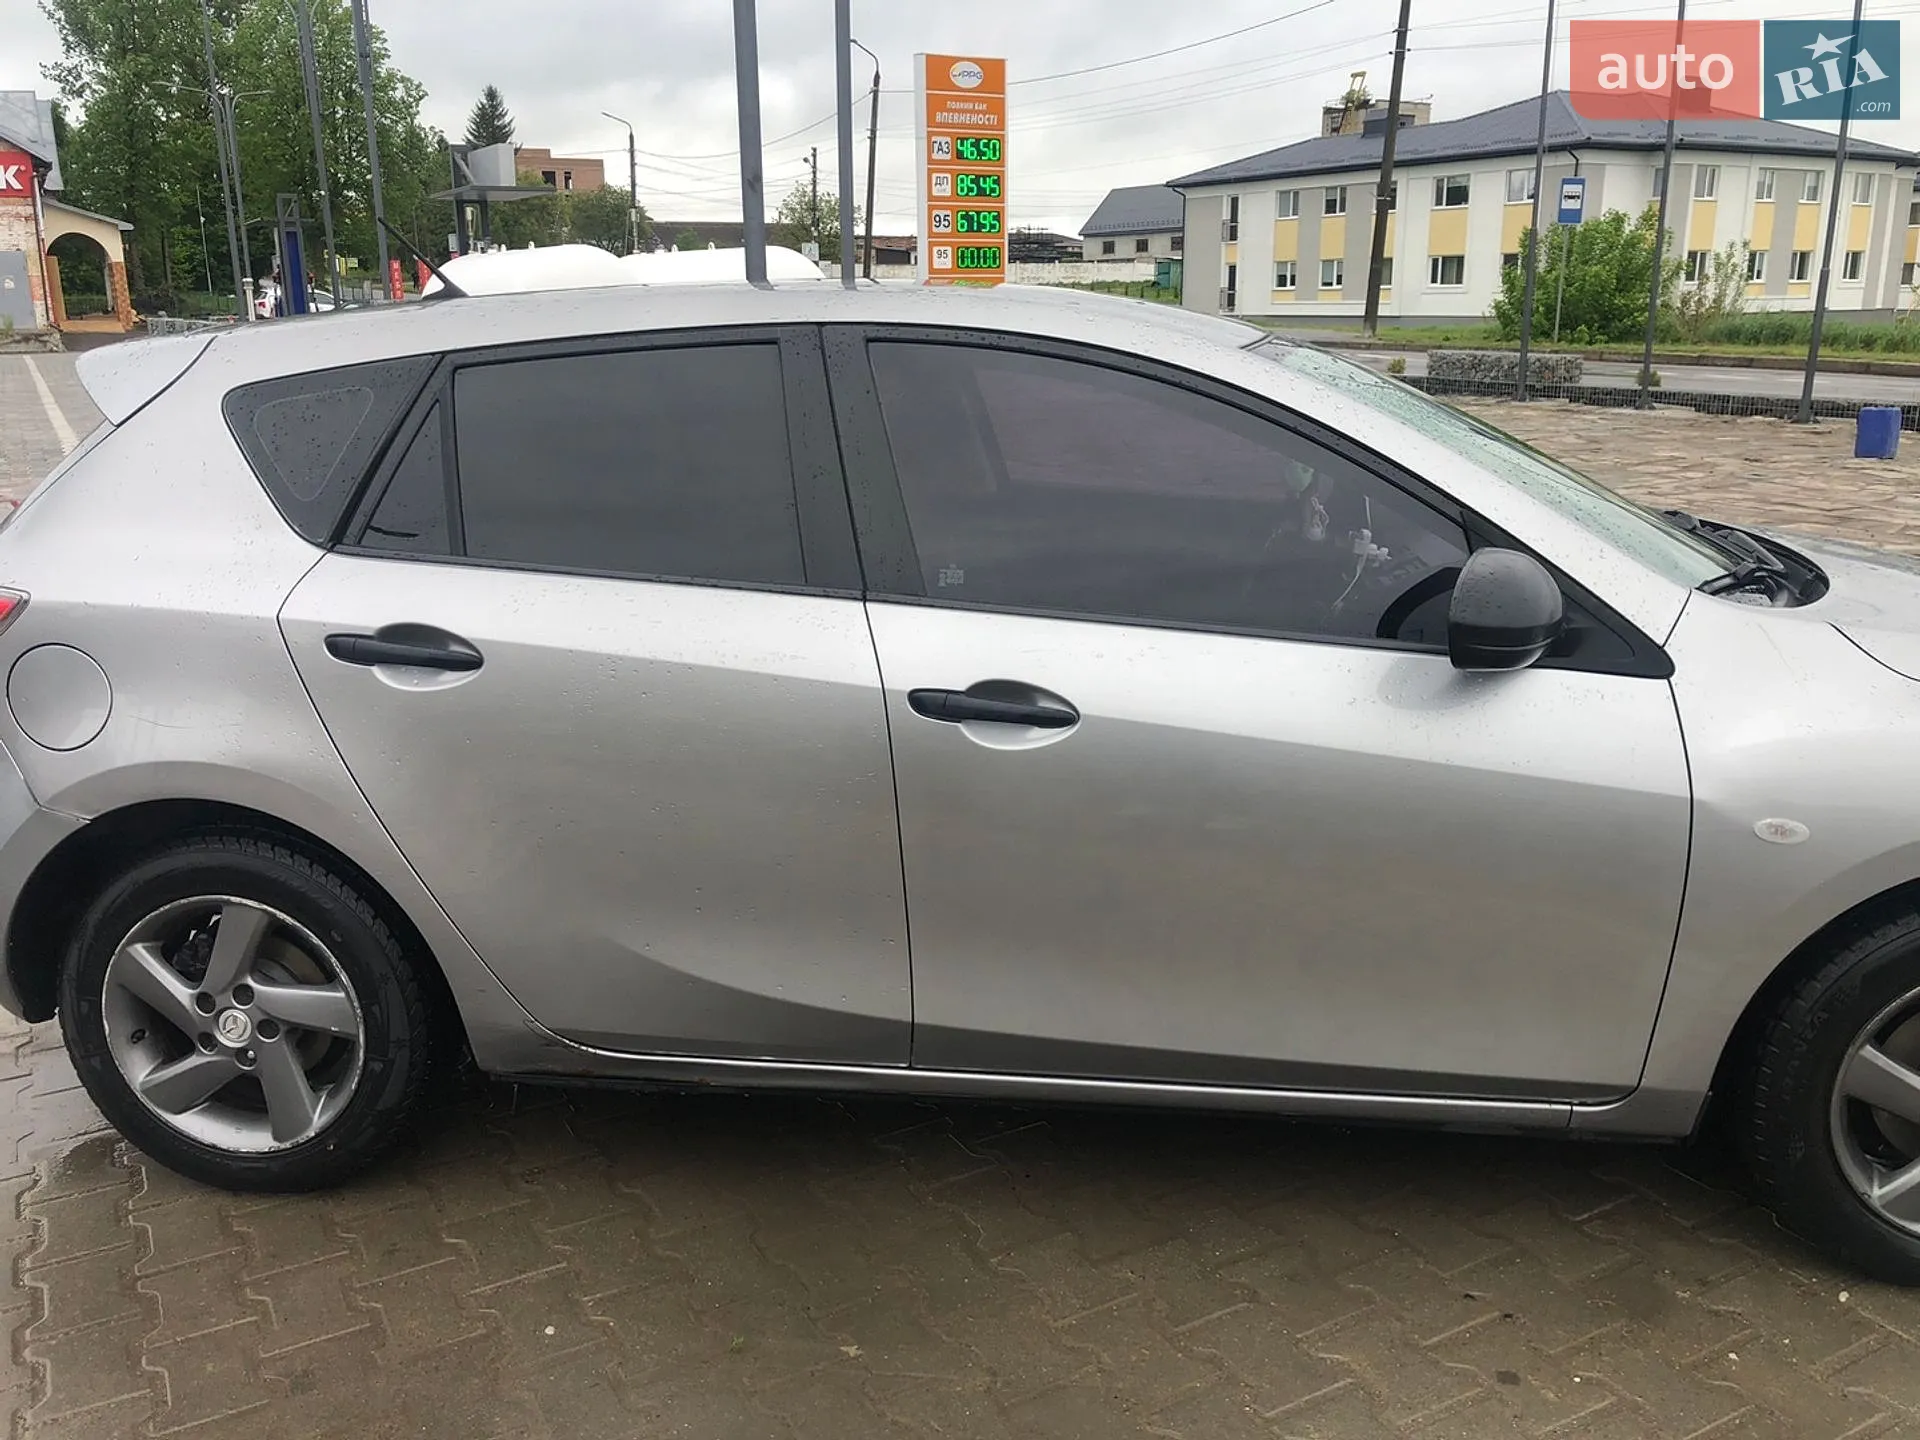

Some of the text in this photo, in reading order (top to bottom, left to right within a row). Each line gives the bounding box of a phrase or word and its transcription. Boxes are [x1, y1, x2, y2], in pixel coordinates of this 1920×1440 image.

[932, 138, 1000, 160] ГАЗ 46.50
[935, 176, 949, 187] ДП
[933, 214, 951, 228] 95
[936, 247, 1000, 268] 95 00.00
